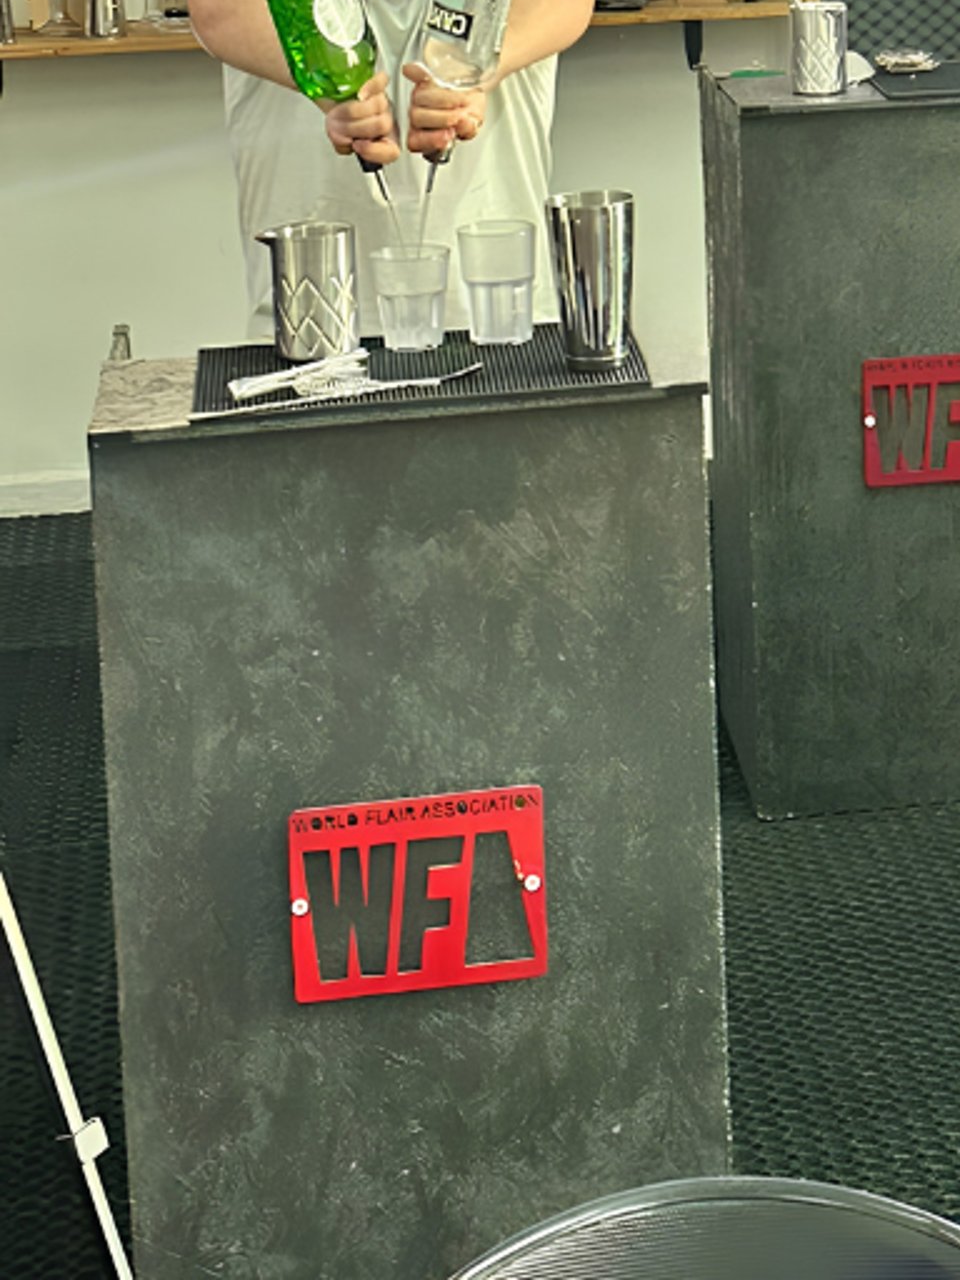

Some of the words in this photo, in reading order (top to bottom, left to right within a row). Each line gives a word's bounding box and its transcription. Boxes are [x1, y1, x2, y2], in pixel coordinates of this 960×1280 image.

[292, 813, 359, 833] WORLD
[365, 807, 416, 826] FLAIR
[420, 793, 539, 819] ASSOCIATION
[302, 831, 536, 983] WFA
